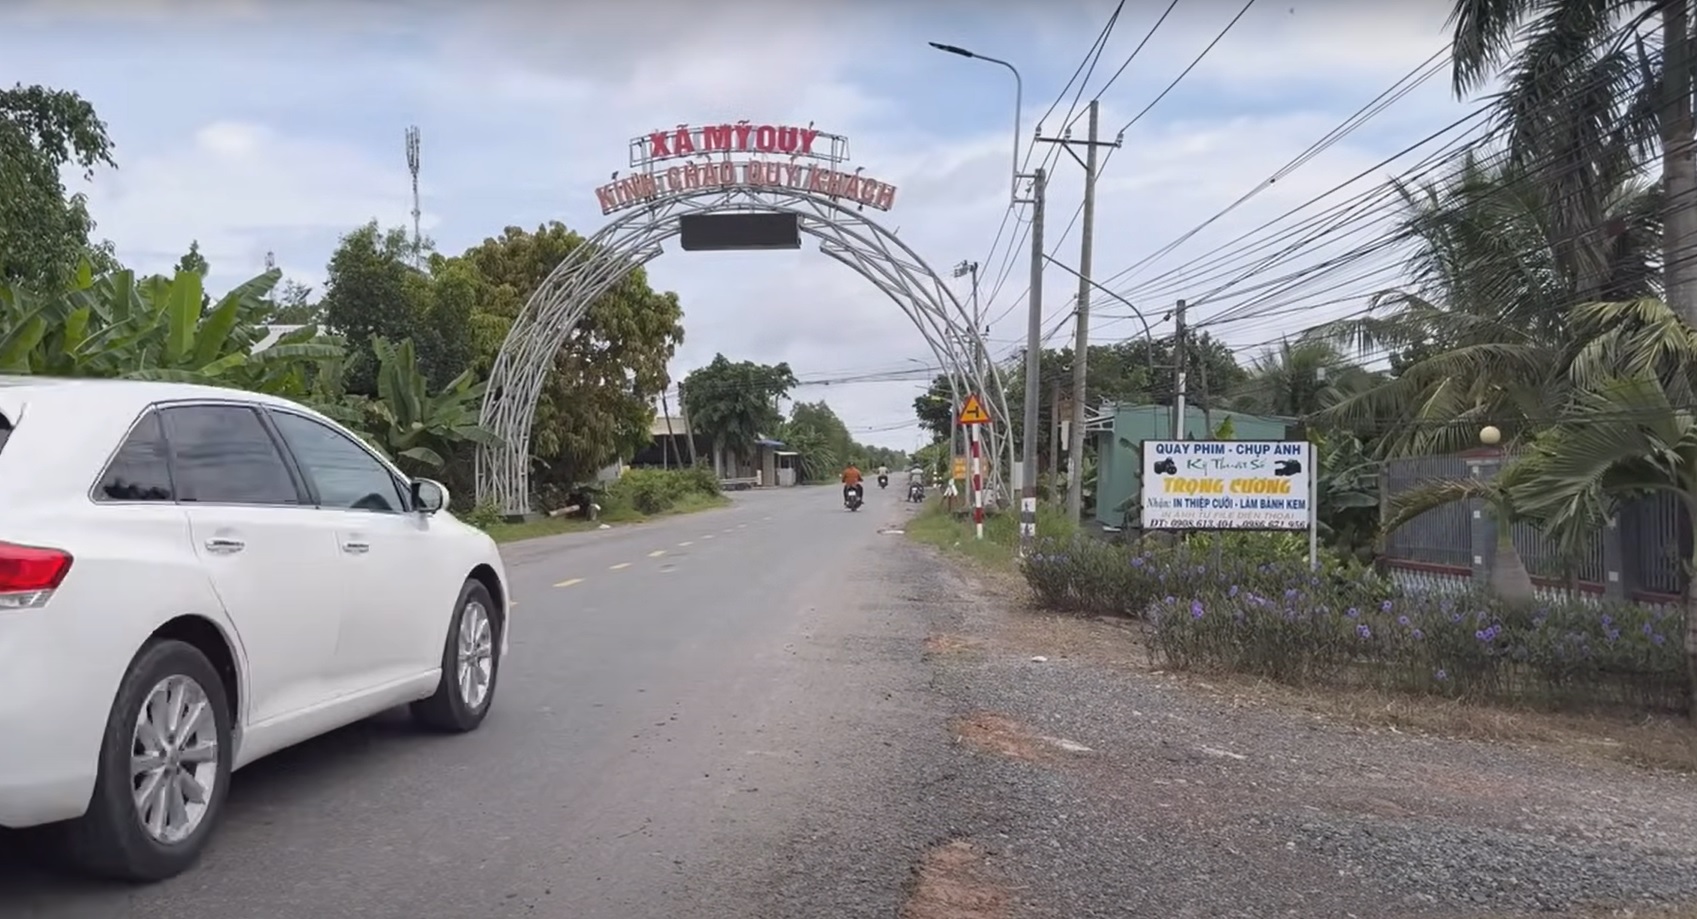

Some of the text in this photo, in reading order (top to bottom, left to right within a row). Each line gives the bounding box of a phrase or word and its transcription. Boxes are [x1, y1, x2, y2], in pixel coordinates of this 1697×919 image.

[650, 124, 695, 158] XÃ
[595, 154, 898, 214] KÍNH CHÀO QUÝ KHÁCH
[1156, 443, 1190, 455] QUAY
[1194, 443, 1225, 454] PHIM
[1236, 444, 1271, 458] CHỤP
[1163, 477, 1225, 496] TRỌNG
[1173, 498, 1183, 508] IN
[1286, 499, 1306, 509] KEM
